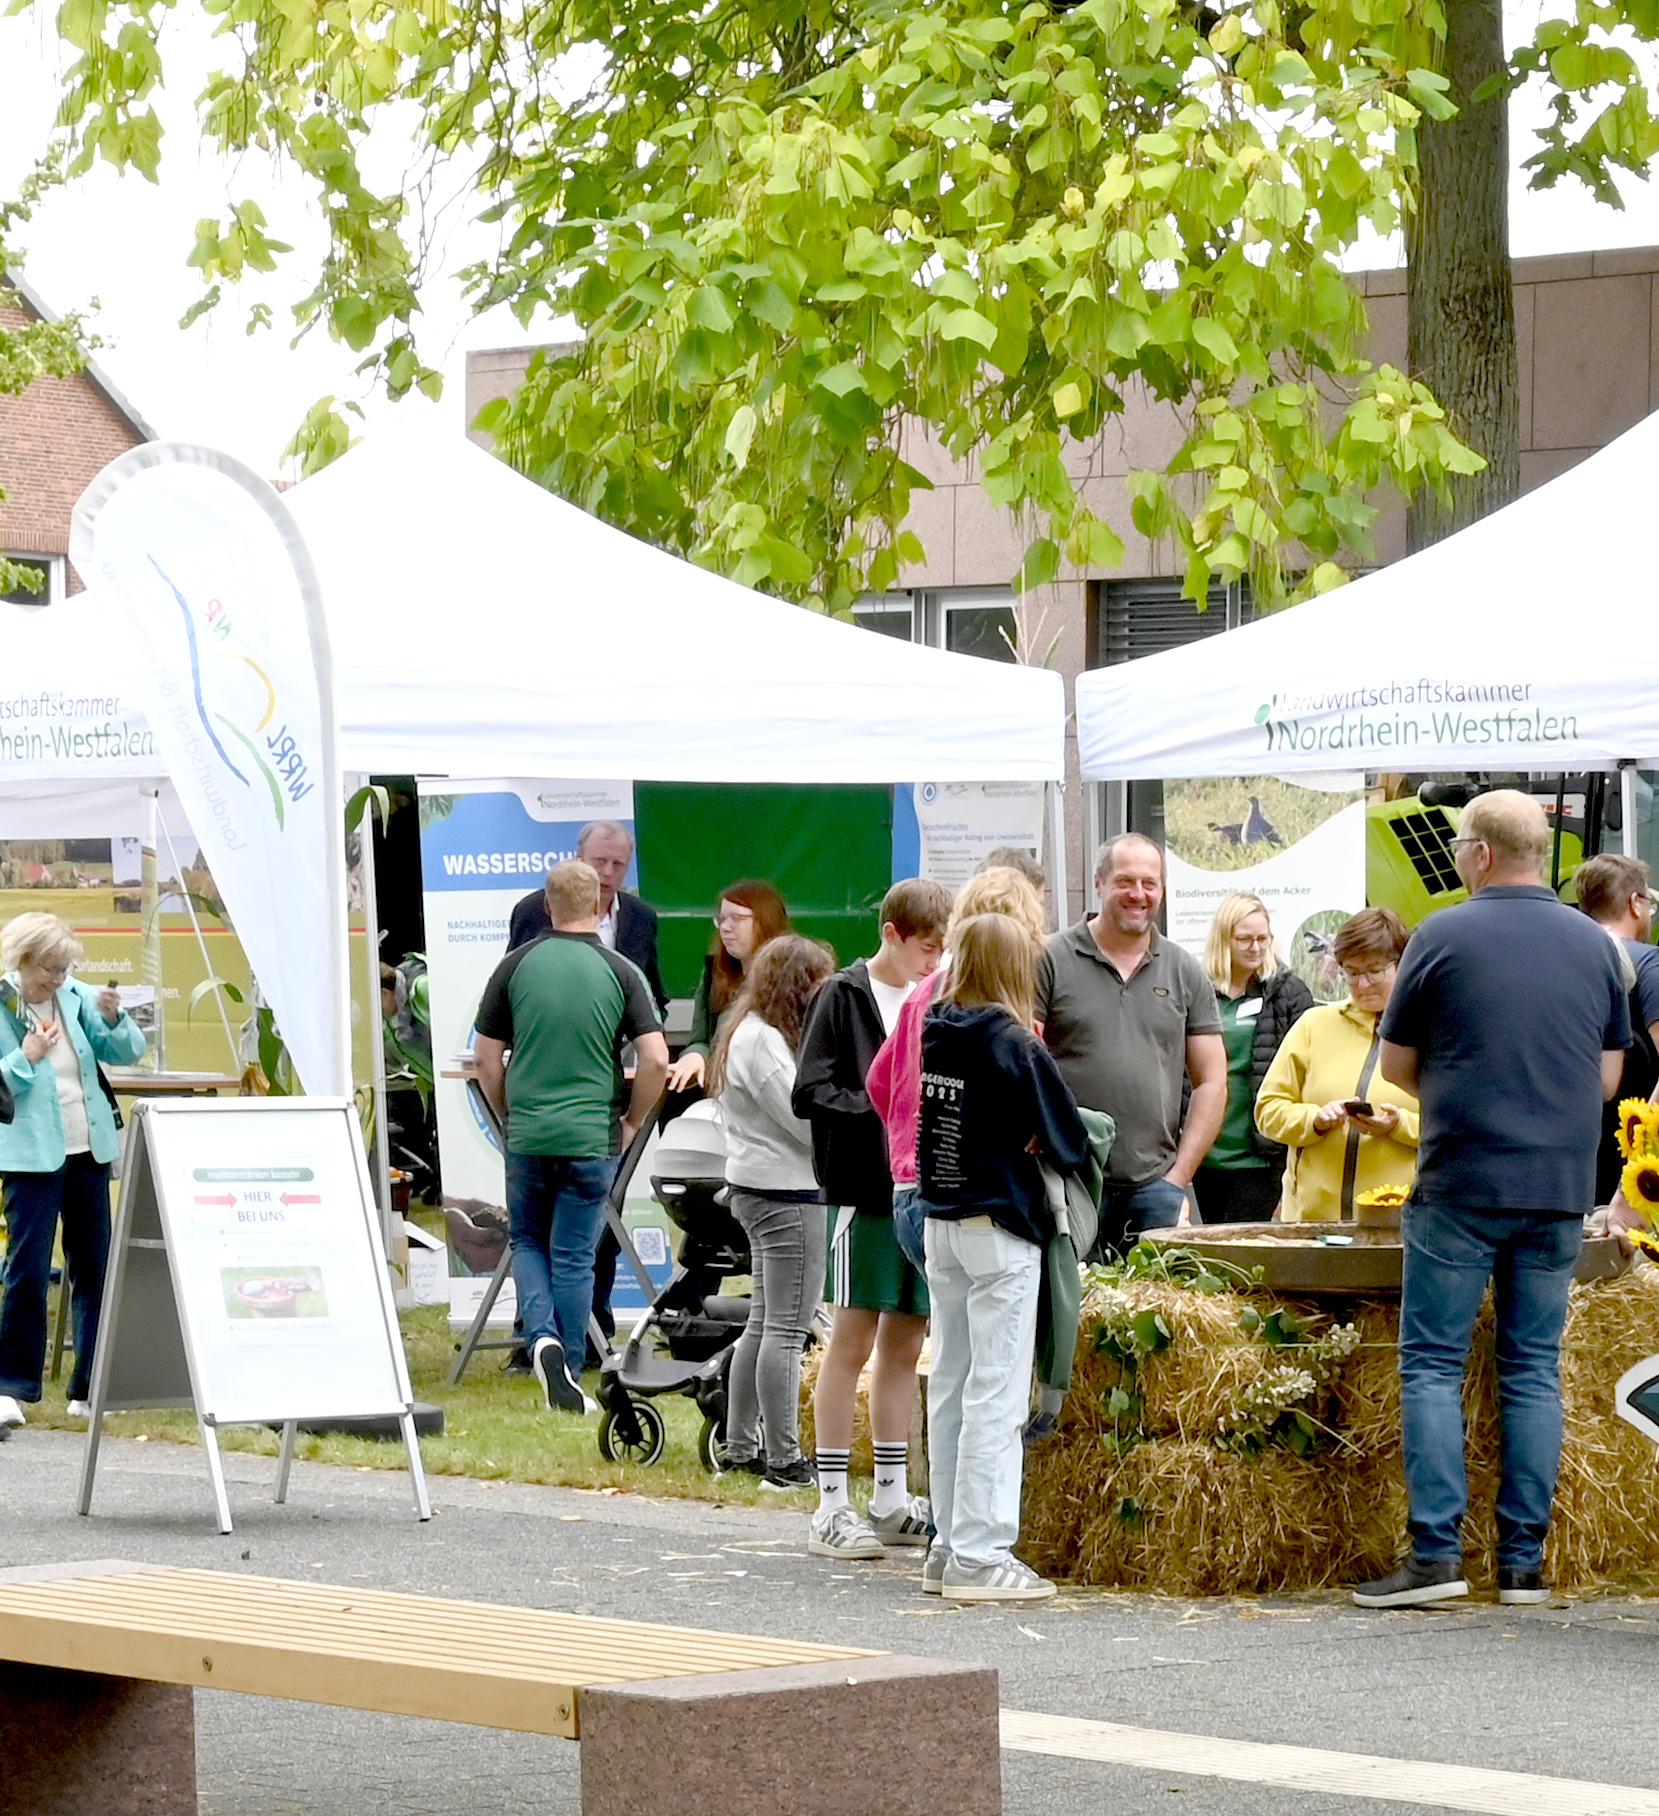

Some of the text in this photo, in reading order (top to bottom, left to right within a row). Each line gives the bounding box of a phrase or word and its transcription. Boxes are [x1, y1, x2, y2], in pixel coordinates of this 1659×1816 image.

[1279, 678, 1532, 713] Landwirtschaftskammer
[1276, 707, 1579, 751] Nordrhein-Westfalen
[443, 851, 579, 876] WASSERSC
[1283, 884, 1312, 896] Acker
[448, 934, 477, 943] DURCH
[244, 1190, 272, 1203] HIER
[238, 1210, 285, 1222] BEI UNS
